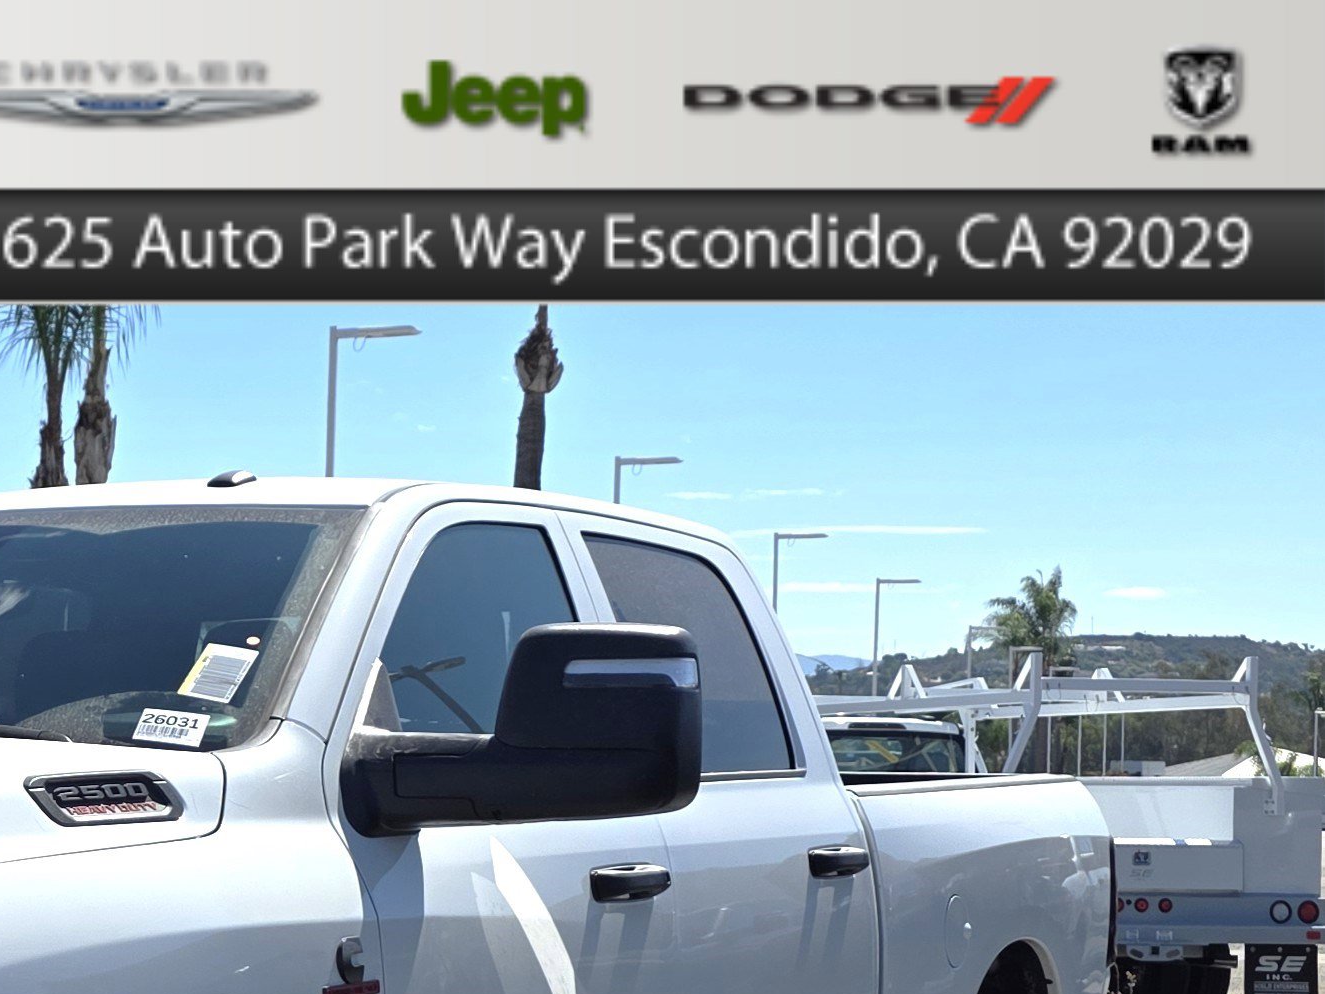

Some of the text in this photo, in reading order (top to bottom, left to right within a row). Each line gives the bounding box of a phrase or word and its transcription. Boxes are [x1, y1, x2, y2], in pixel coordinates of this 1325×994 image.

[142, 713, 199, 729] 26031
[53, 782, 149, 802] 2500
[65, 801, 158, 816] HEAVY DUTY
[1254, 955, 1307, 972] SE
